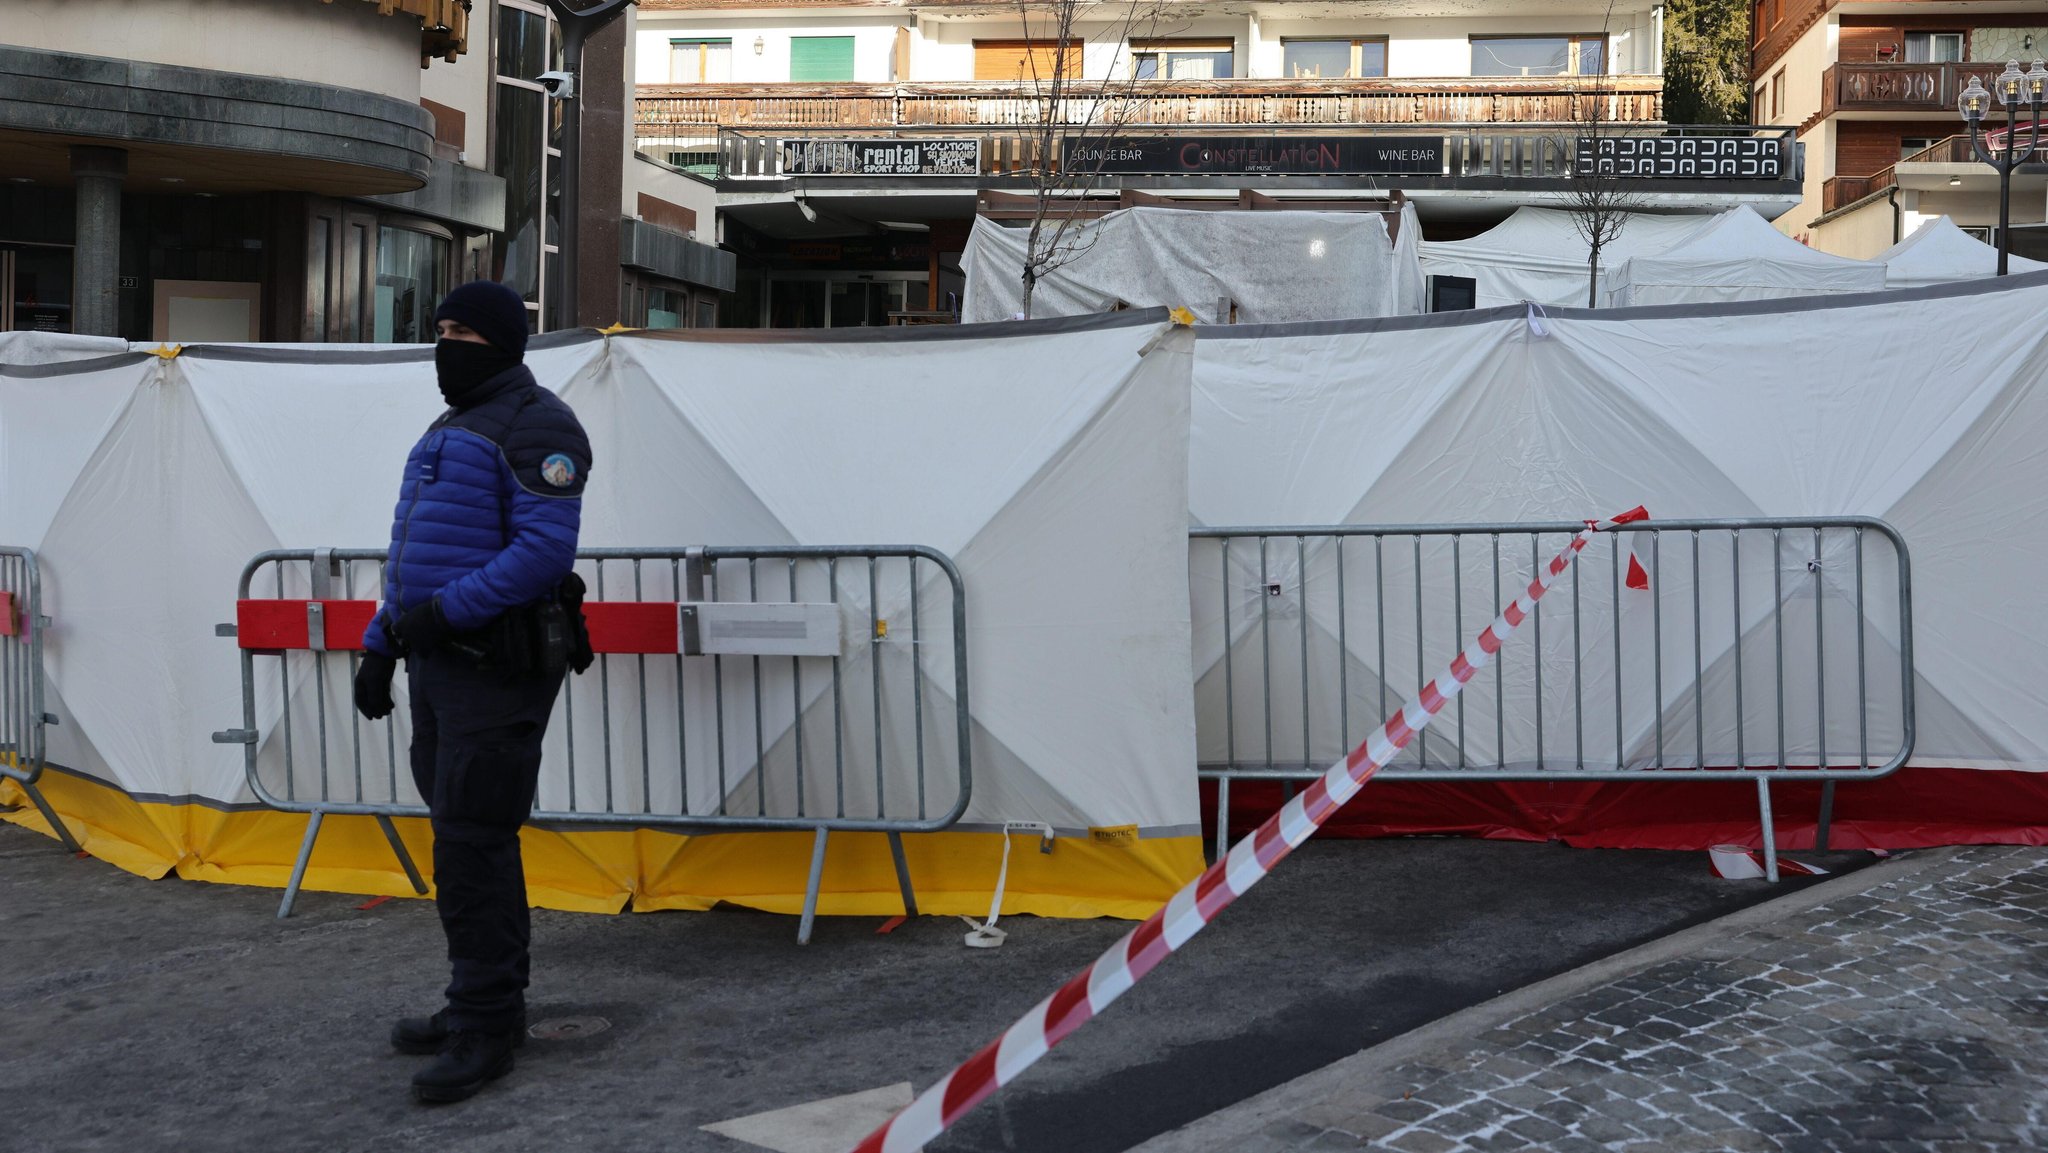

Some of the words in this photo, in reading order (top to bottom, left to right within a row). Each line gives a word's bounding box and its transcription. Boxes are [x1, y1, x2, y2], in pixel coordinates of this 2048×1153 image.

[922, 142, 976, 151] LOCATIONS
[864, 145, 919, 165] rental
[1071, 149, 1117, 160] LOUNGE
[1120, 149, 1142, 160] BAR
[1378, 149, 1408, 161] WINE
[1412, 149, 1435, 161] BAR
[934, 157, 966, 166] VENTE
[864, 165, 893, 173] SPORT
[896, 165, 920, 173] SHOP
